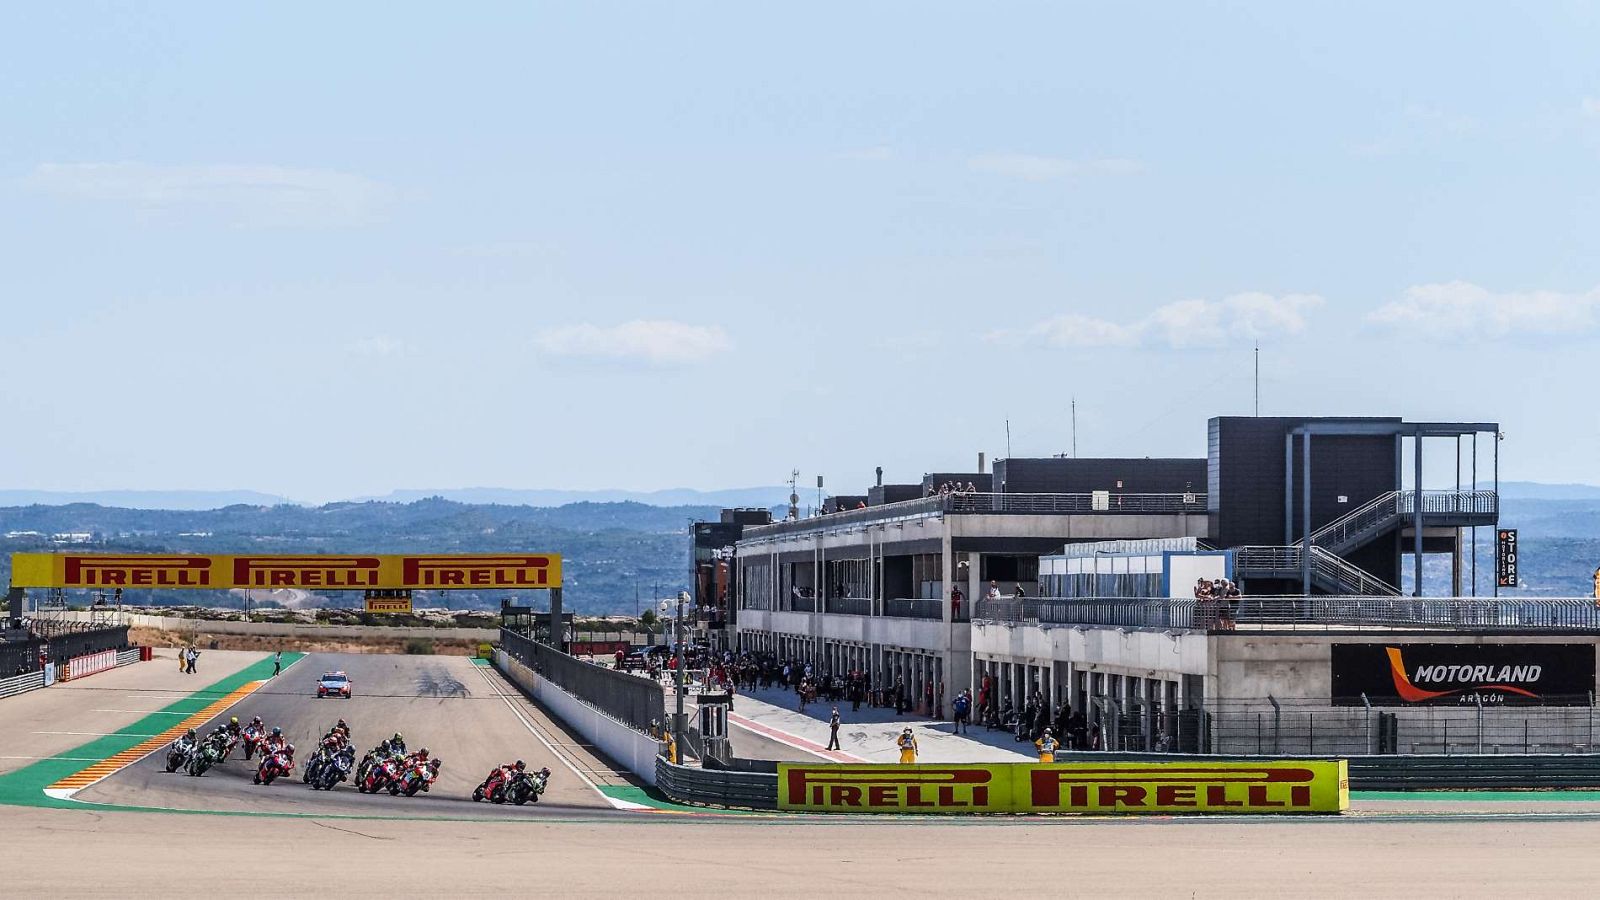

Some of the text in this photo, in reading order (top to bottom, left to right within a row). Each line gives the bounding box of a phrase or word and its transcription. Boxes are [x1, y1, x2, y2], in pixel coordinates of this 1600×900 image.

[64, 556, 212, 586] PIRELLI
[233, 557, 381, 586] PIRELLI
[402, 556, 550, 586] PIRELLI
[1507, 531, 1516, 585] STORE
[368, 600, 408, 610] PIRELLI
[1414, 664, 1542, 682] MOTORLAND
[787, 769, 992, 806] PIRELLI
[1031, 767, 1315, 807] PIRELLI
